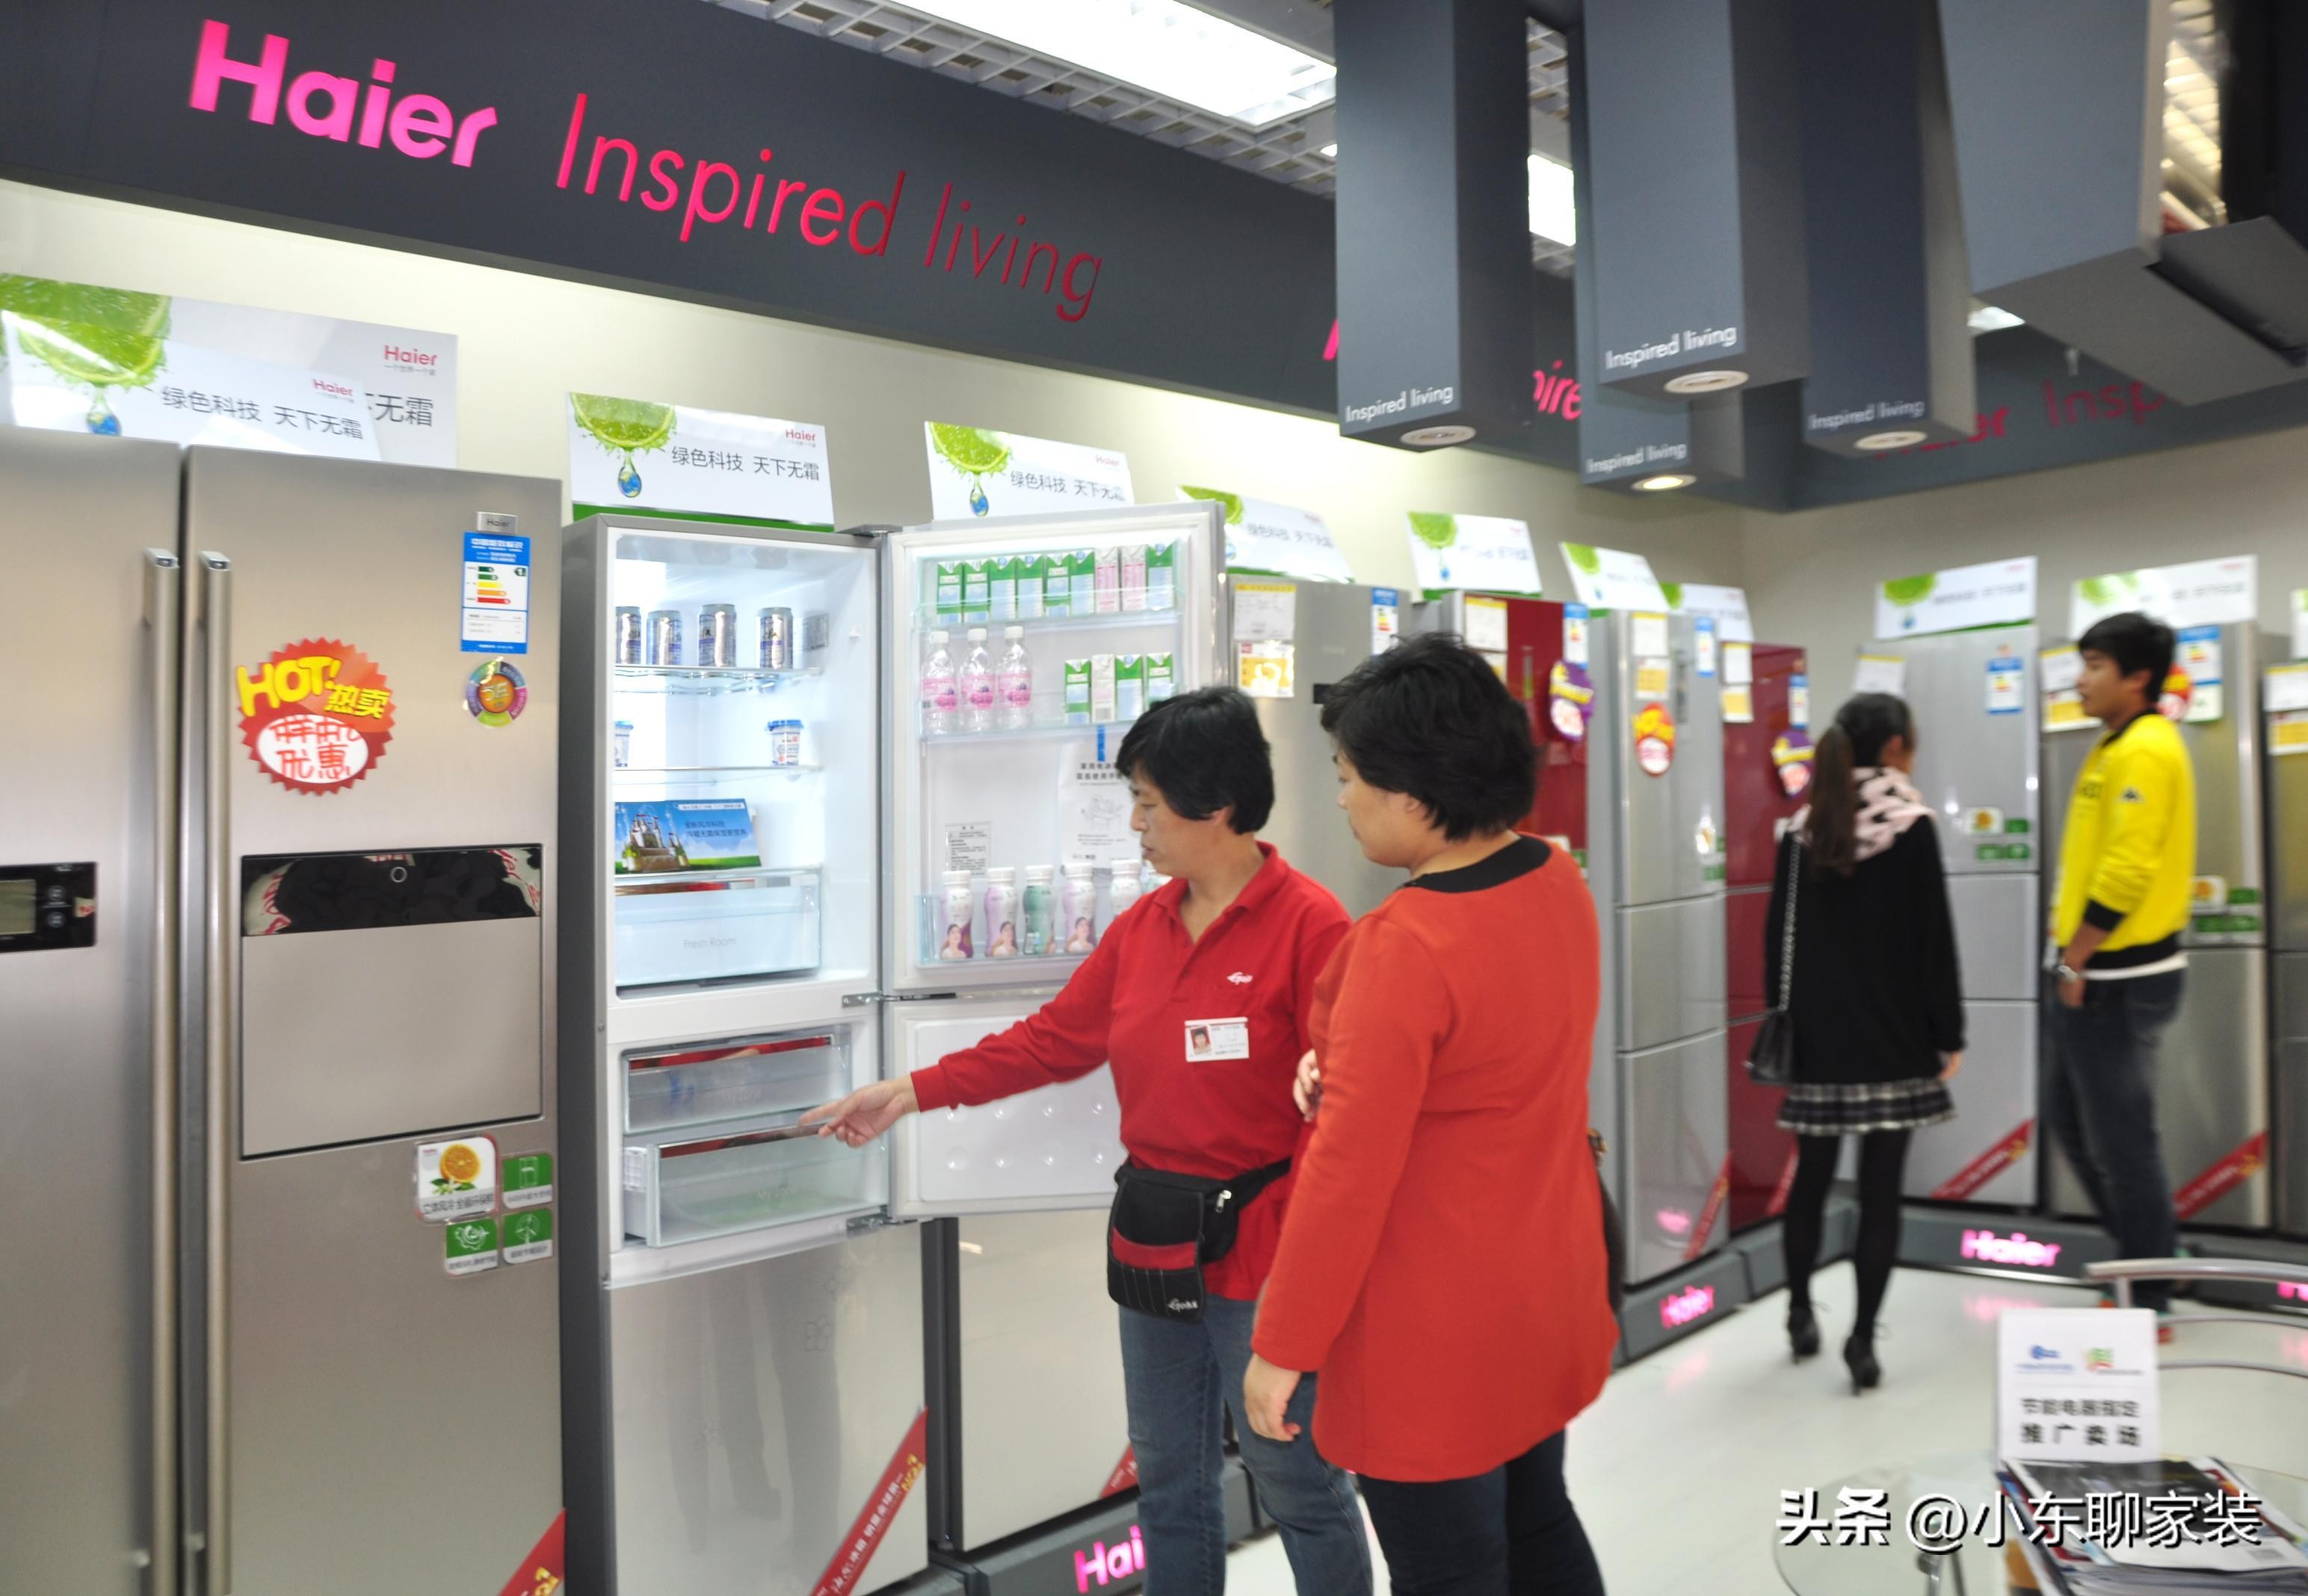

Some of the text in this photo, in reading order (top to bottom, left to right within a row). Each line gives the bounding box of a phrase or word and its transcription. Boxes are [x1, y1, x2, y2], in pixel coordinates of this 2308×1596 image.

[189, 19, 1102, 323] Haier Inspired living
[383, 344, 438, 367] Haier
[1605, 327, 1737, 369] Inspired living
[312, 378, 354, 397] Haier
[1345, 386, 1454, 423] Inspired living
[161, 386, 363, 440] 绿色科技 天下无霜
[1808, 403, 1875, 431] Inspired
[1876, 401, 1925, 418] living
[786, 429, 816, 442] Haier
[671, 445, 819, 481] 绿色科技 天下无霜
[1586, 444, 1687, 474] Inspired living
[1010, 470, 1067, 494] 绿色科技
[236, 655, 342, 717] HOT!
[324, 684, 391, 720] 热卖
[1960, 1228, 2062, 1268] Haier
[1073, 1524, 1147, 1594] Hai
